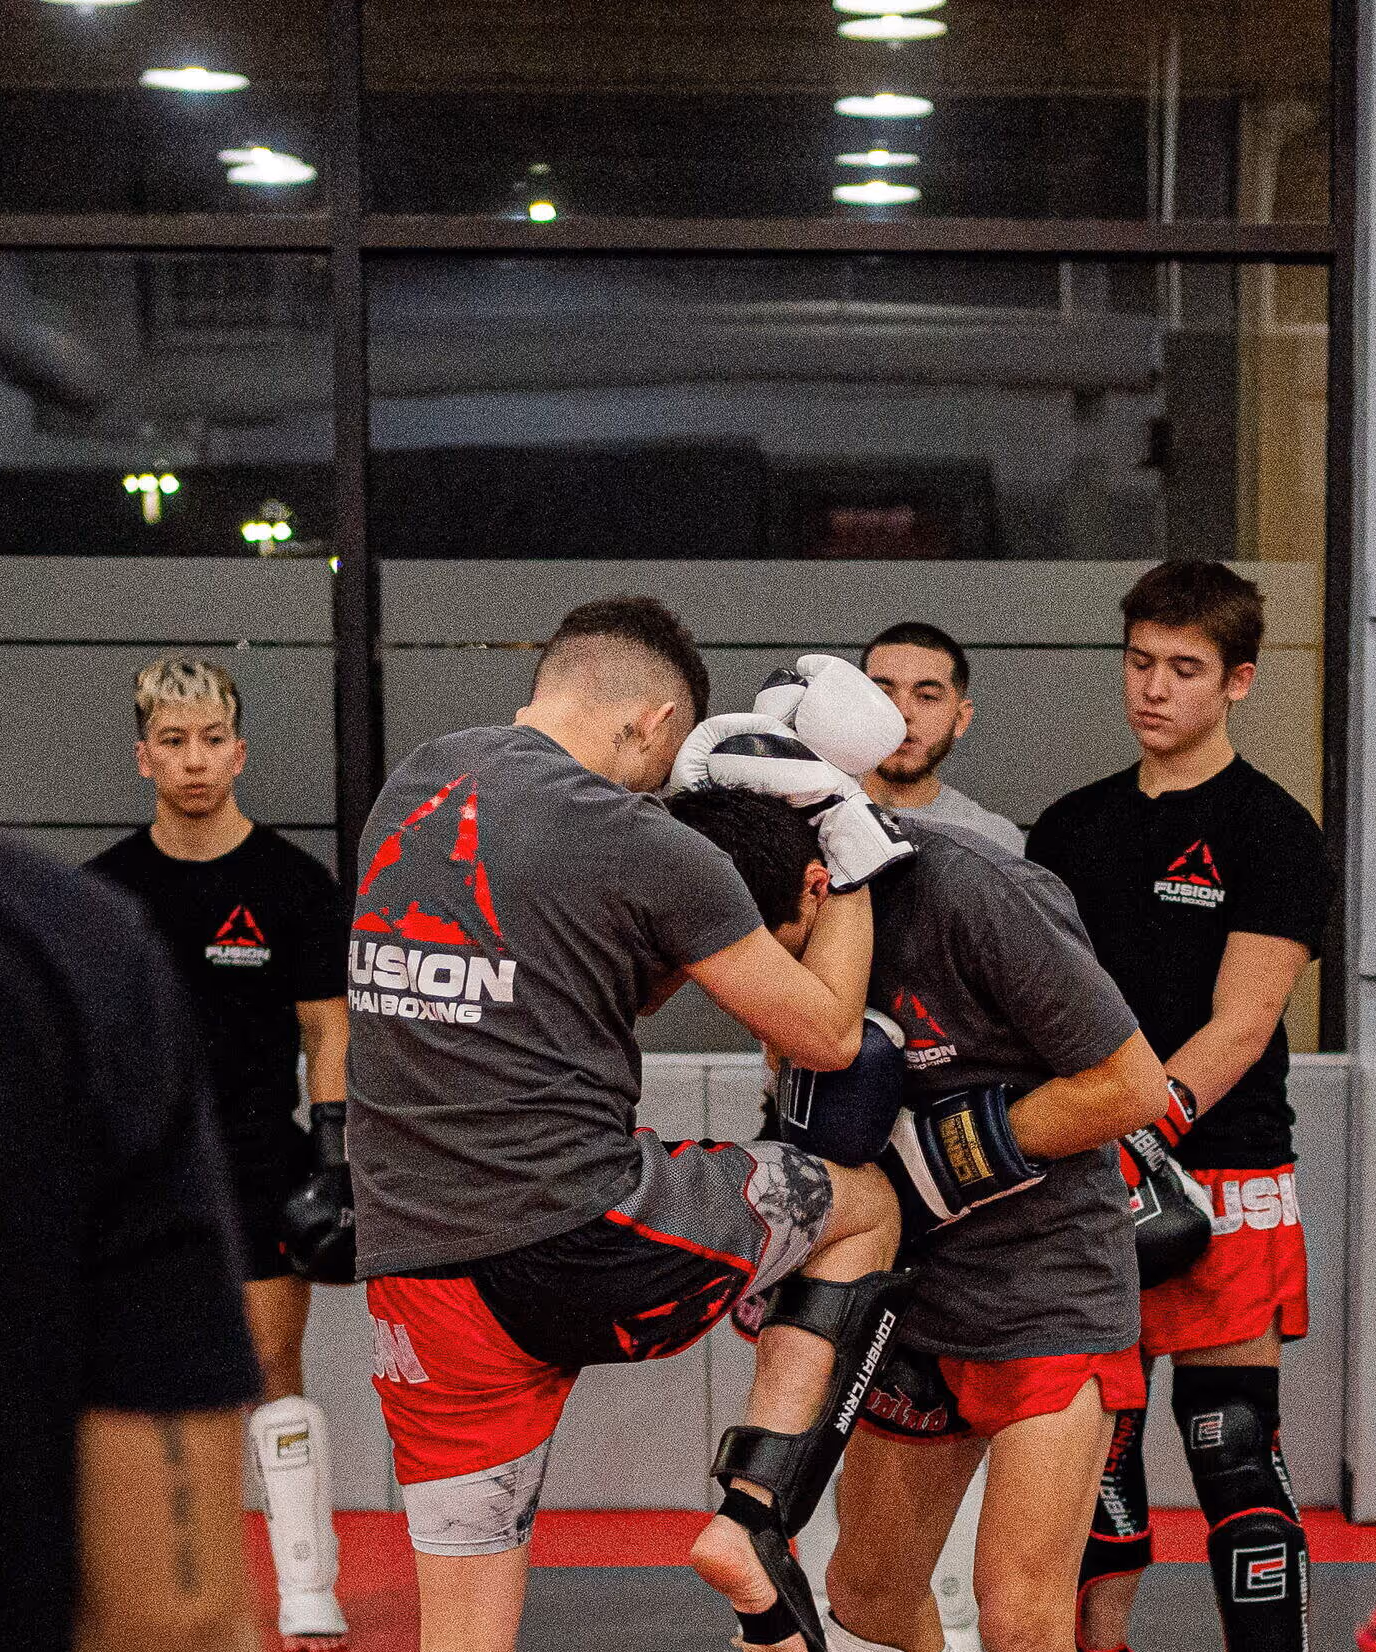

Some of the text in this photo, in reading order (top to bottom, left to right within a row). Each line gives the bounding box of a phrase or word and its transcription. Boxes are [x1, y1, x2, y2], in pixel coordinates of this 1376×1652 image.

[1153, 881, 1226, 903] FUSION
[205, 945, 271, 961] FUSION
[348, 939, 517, 1003] USION
[380, 993, 483, 1024] BOXING
[834, 1308, 897, 1435] COMBATCRNR
